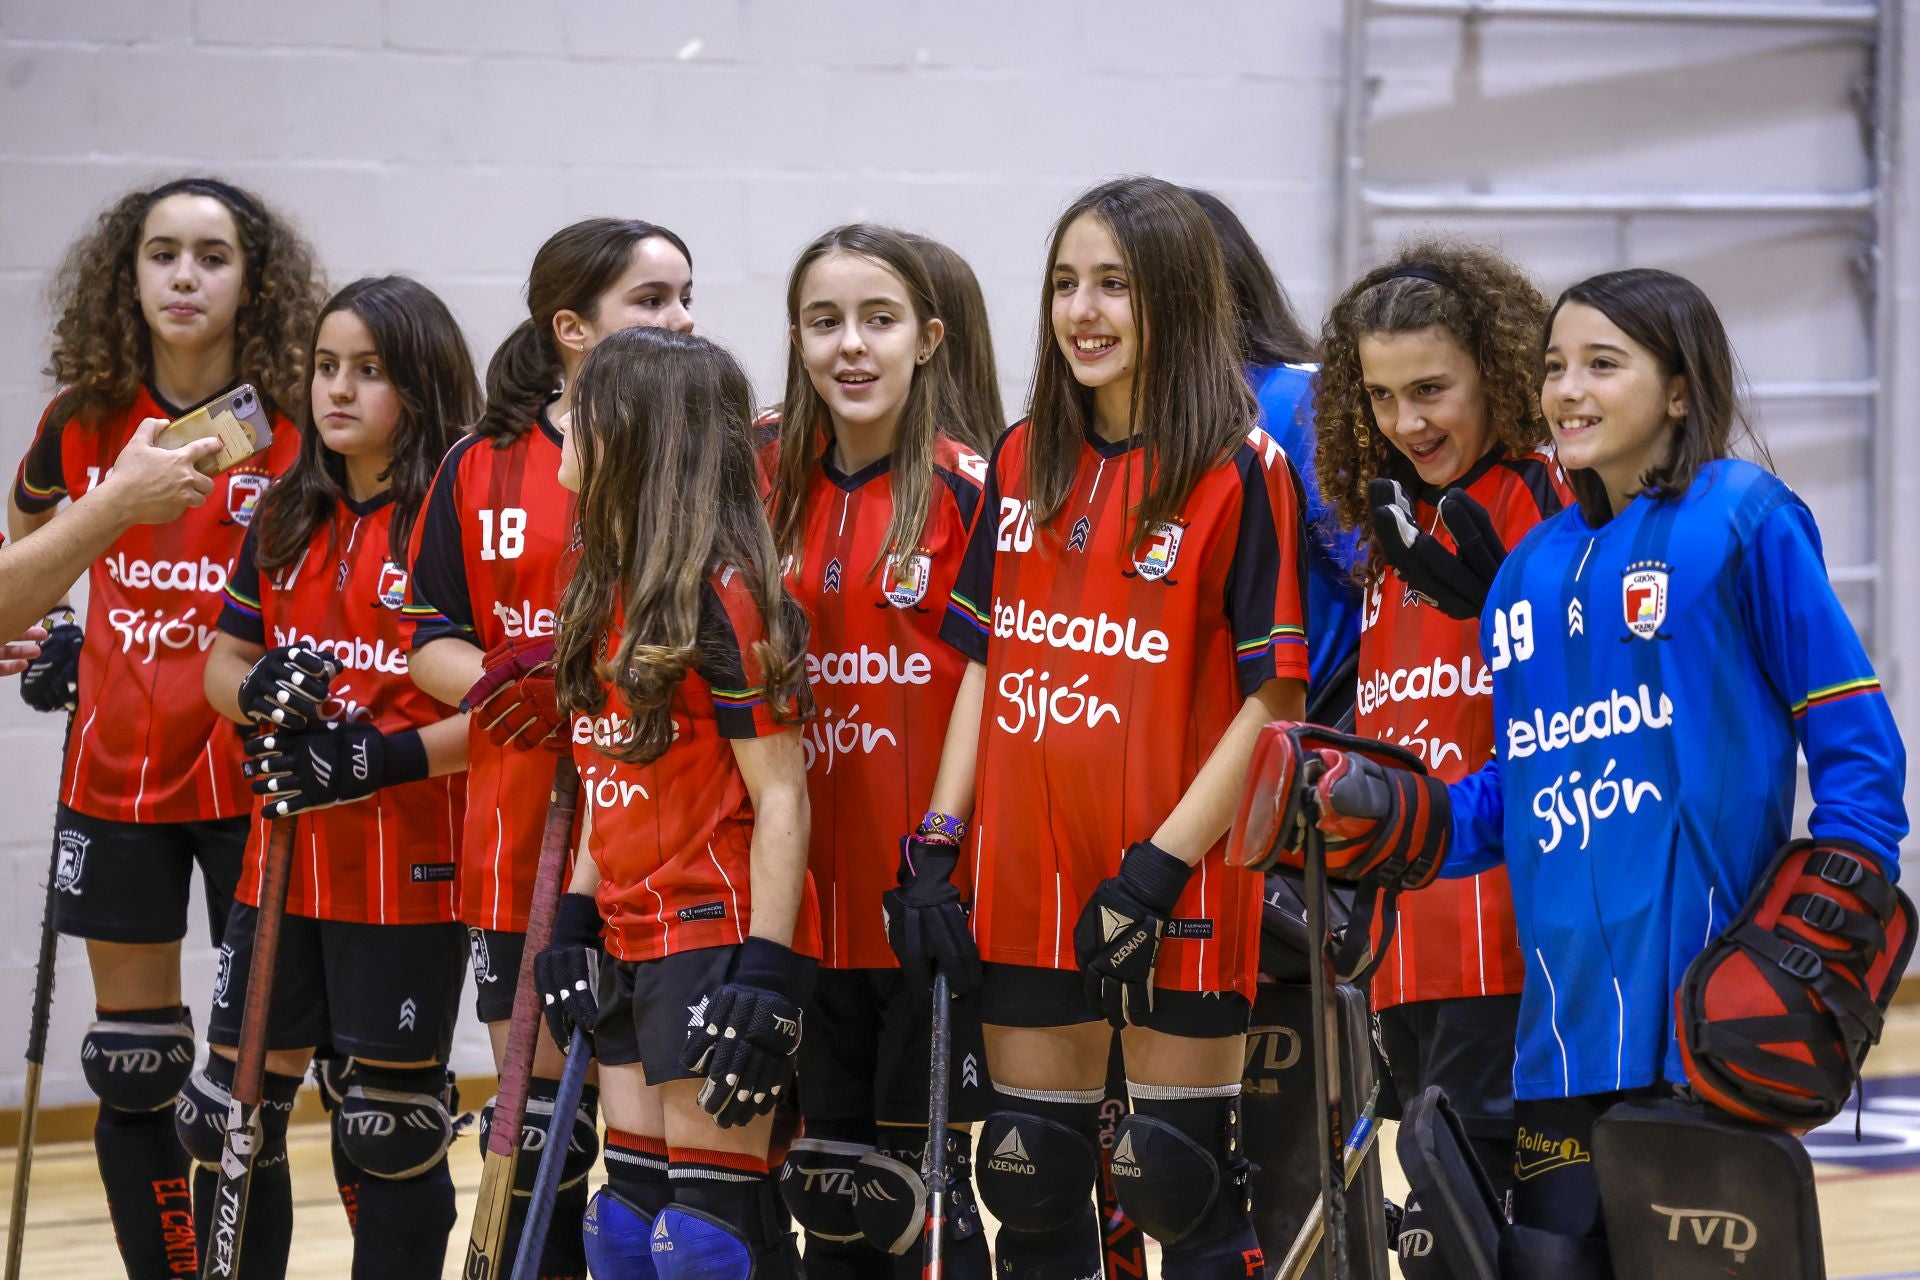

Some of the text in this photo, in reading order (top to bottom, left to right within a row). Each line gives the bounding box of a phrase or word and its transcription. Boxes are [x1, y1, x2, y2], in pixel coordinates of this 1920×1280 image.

[478, 507, 527, 561] 18
[996, 496, 1034, 553] 20
[993, 596, 1169, 663] telecable
[995, 668, 1121, 742] gijón
[1356, 655, 1494, 717] telecable
[352, 738, 368, 780] TVD
[1532, 758, 1663, 854] gijón
[1110, 930, 1148, 968] AZEMAD
[772, 1013, 797, 1037] TVD
[102, 1049, 162, 1074] TVD
[341, 1110, 396, 1136] TVD
[1516, 1126, 1561, 1154] Roller
[988, 1159, 1036, 1175] AZEMAD
[1111, 1163, 1141, 1178] AZEMAD
[151, 1177, 189, 1205] EL
[208, 1185, 241, 1278] JOKER
[1651, 1203, 1758, 1252] TVD
